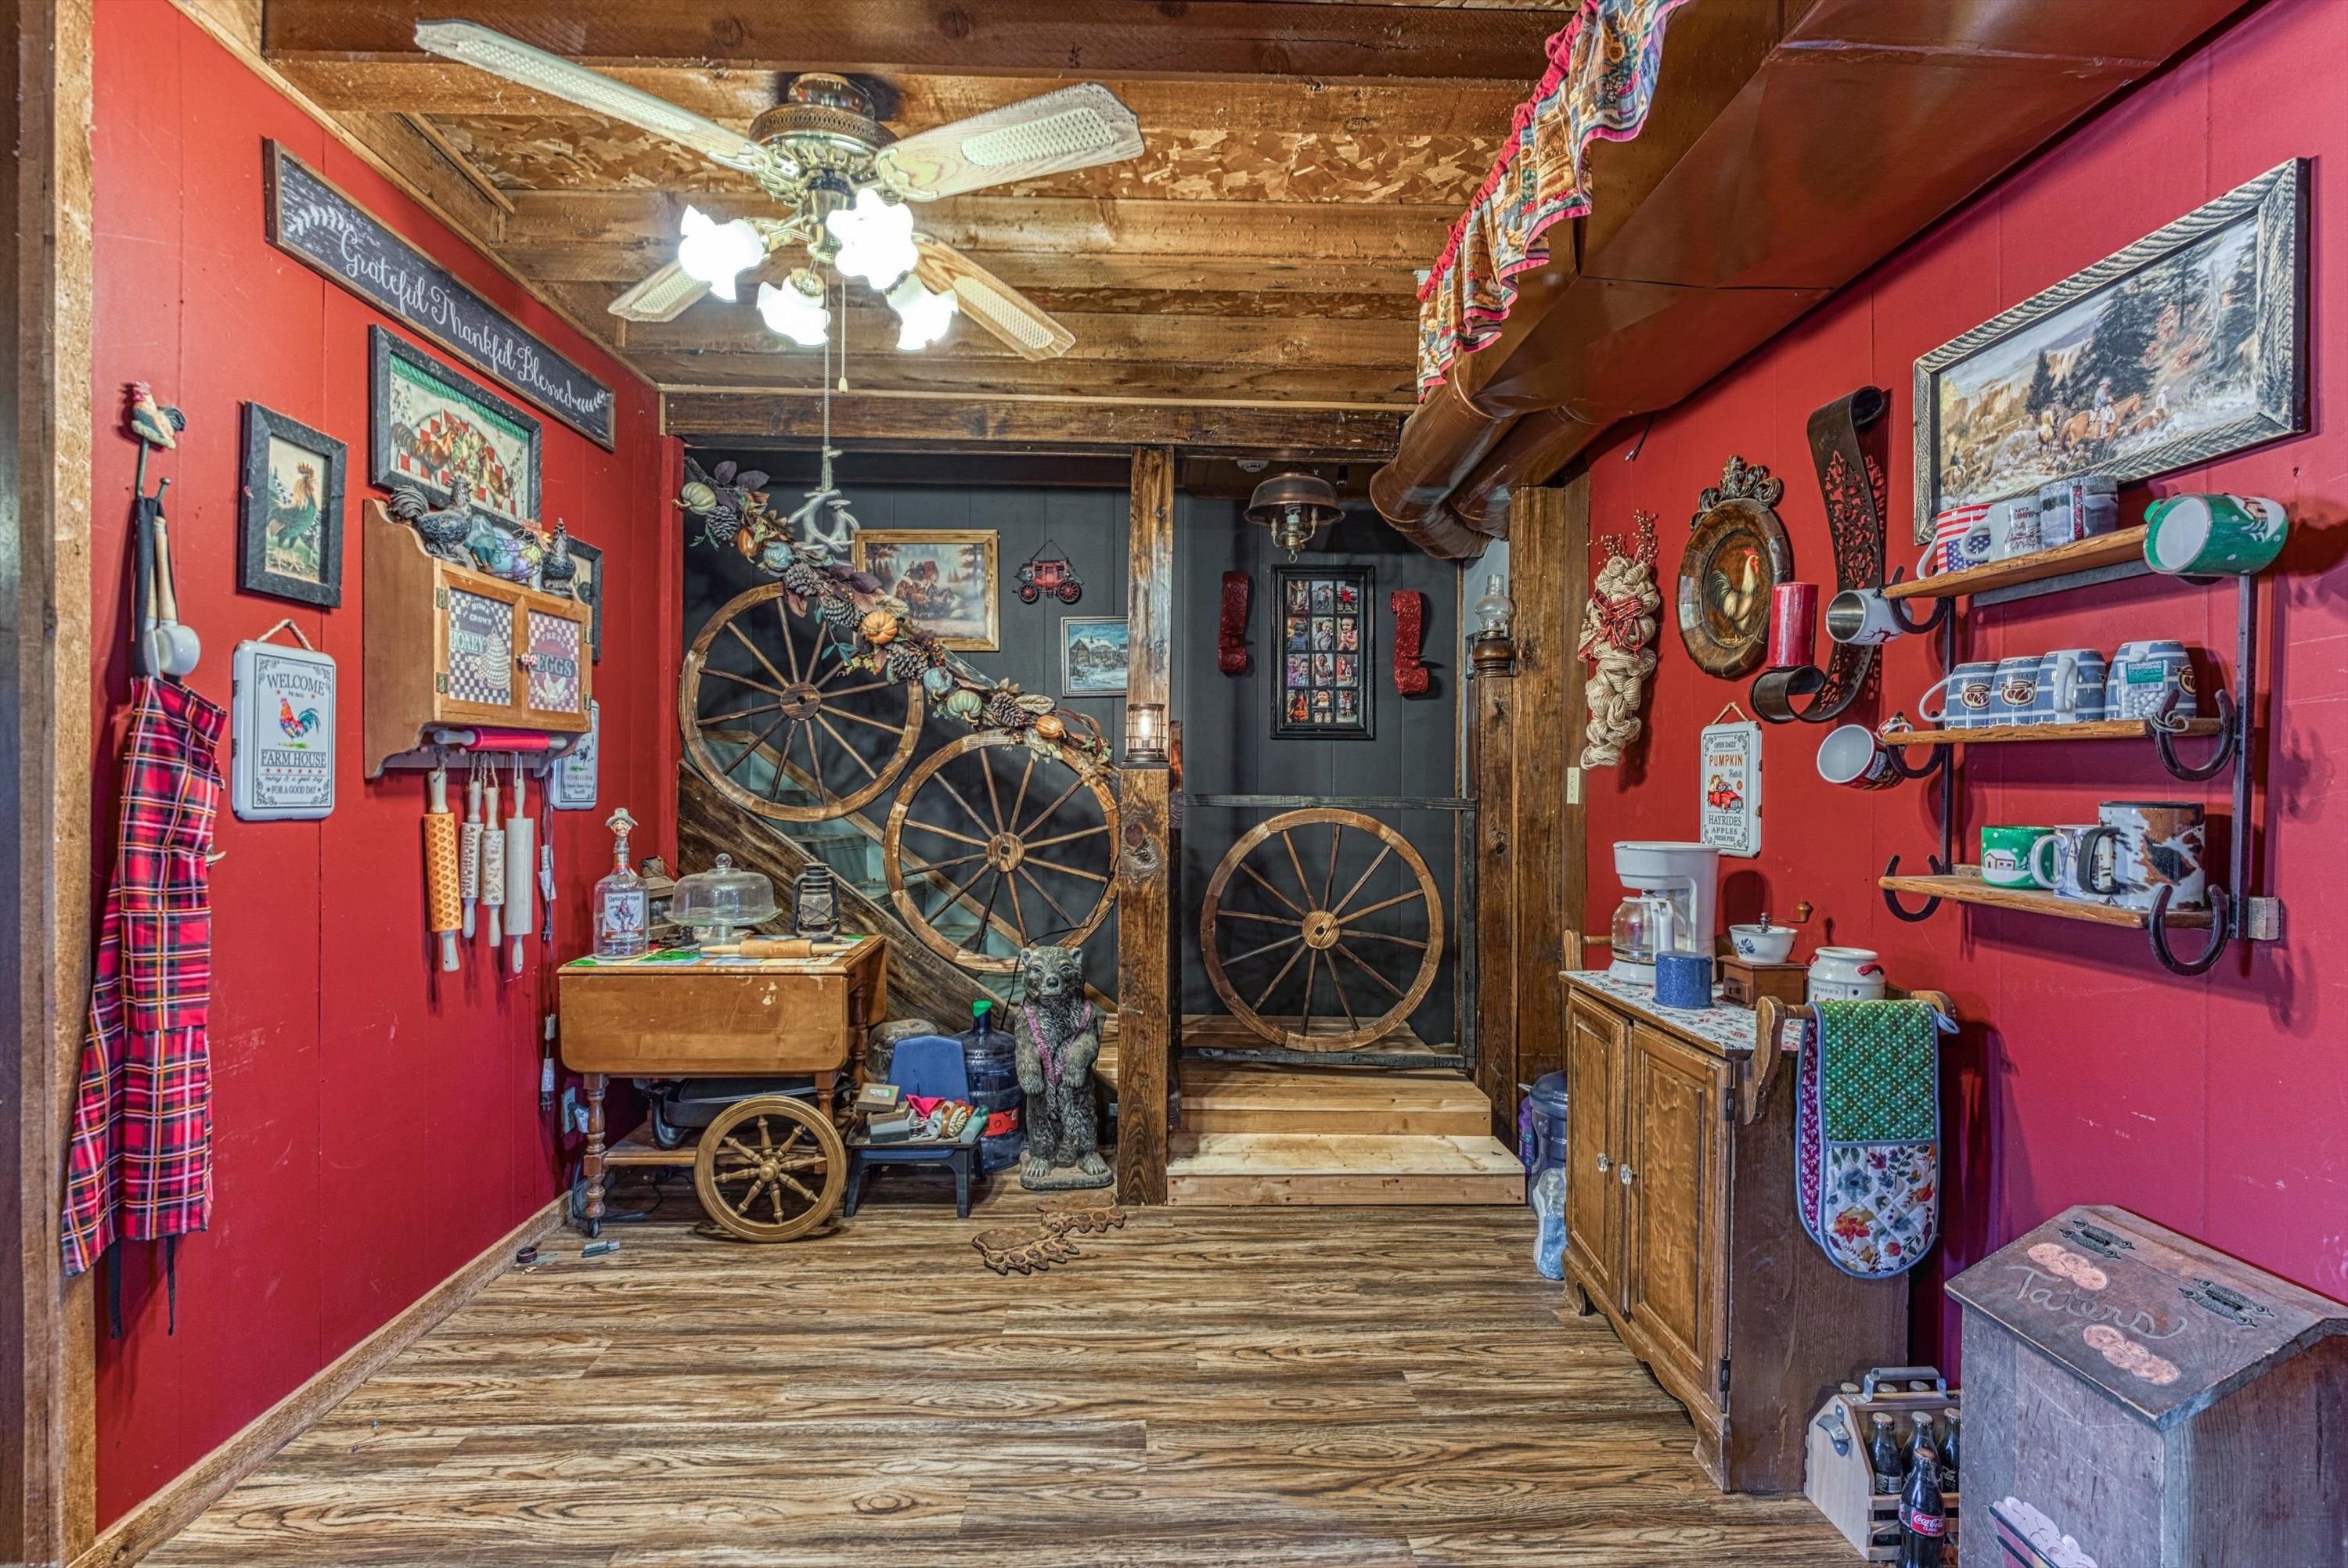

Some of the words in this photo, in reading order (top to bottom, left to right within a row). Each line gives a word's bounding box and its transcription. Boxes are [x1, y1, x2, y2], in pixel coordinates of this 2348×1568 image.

[341, 230, 430, 315] Grateful
[429, 285, 518, 374] Thankful
[517, 346, 573, 408] Blessed
[471, 602, 492, 614] HOME
[470, 613, 492, 626] GROWN
[451, 630, 485, 653] HONEY
[536, 653, 572, 676] EGGS
[267, 673, 325, 696] WELCOME
[261, 751, 290, 765] FARM
[294, 753, 326, 766] HOUSE
[1709, 753, 1743, 768] PUMPKIN
[1728, 768, 1743, 779] Patch
[272, 786, 283, 794] FOR
[283, 786, 288, 794] A
[289, 786, 304, 794] GOOD
[305, 786, 316, 794] DAY
[1709, 815, 1741, 826] HAYRIDES
[2004, 1264, 2188, 1339] Taters
